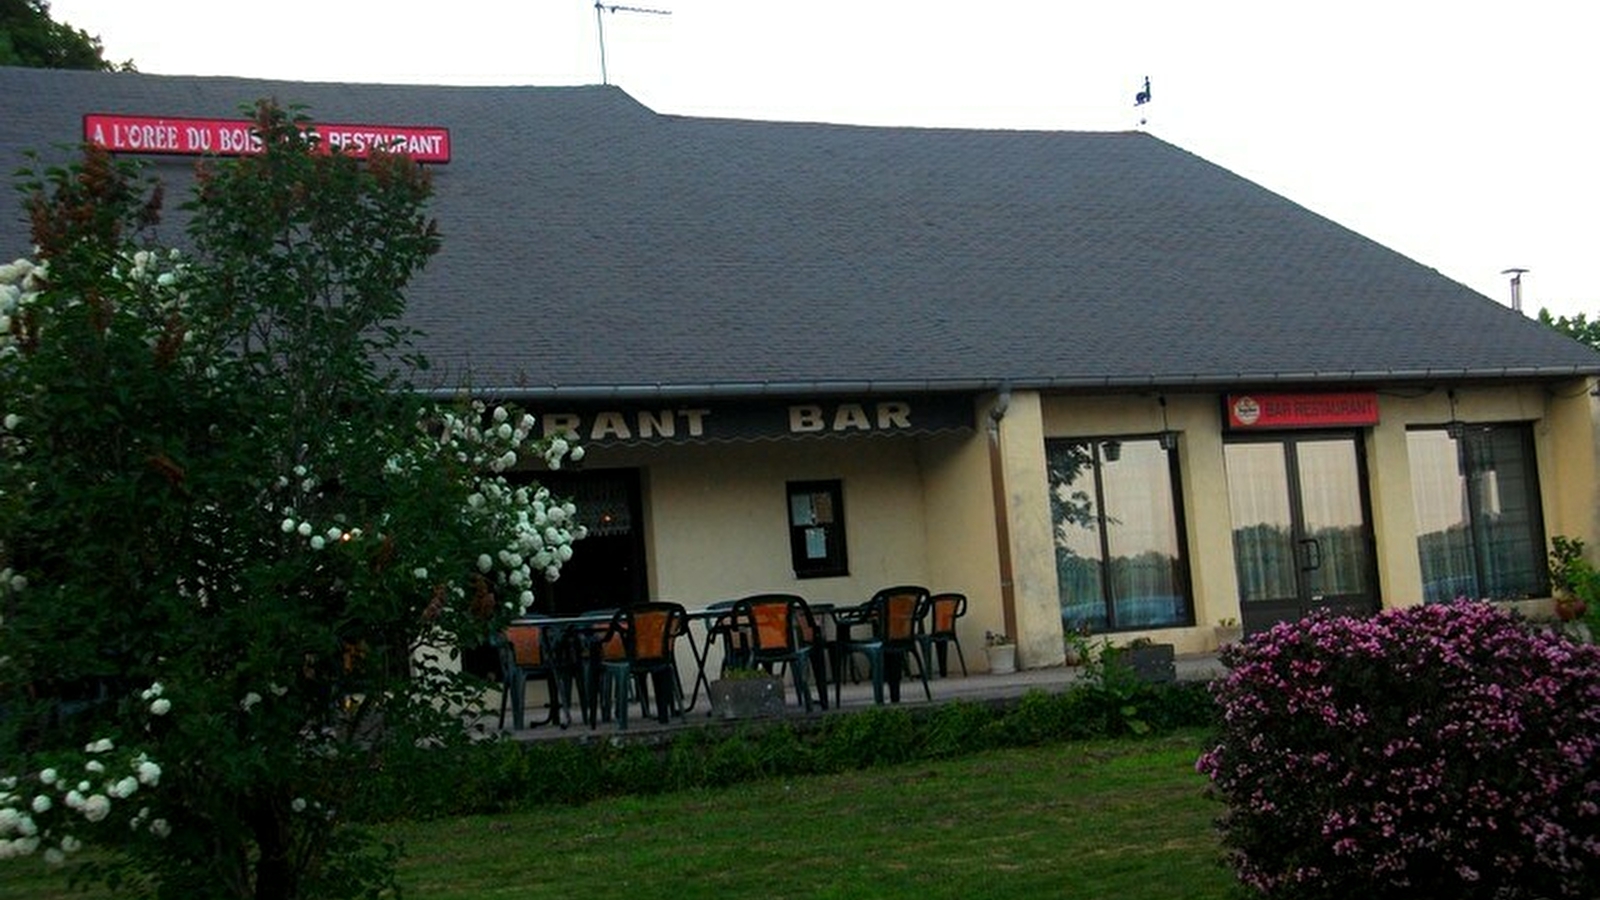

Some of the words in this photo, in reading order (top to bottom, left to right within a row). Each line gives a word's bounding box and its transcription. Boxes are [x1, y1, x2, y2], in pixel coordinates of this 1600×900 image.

[93, 124, 105, 146] A
[113, 120, 179, 149] L'ORÉE
[186, 127, 211, 150] DU
[788, 401, 912, 433] BAR
[1265, 400, 1291, 417] BAR
